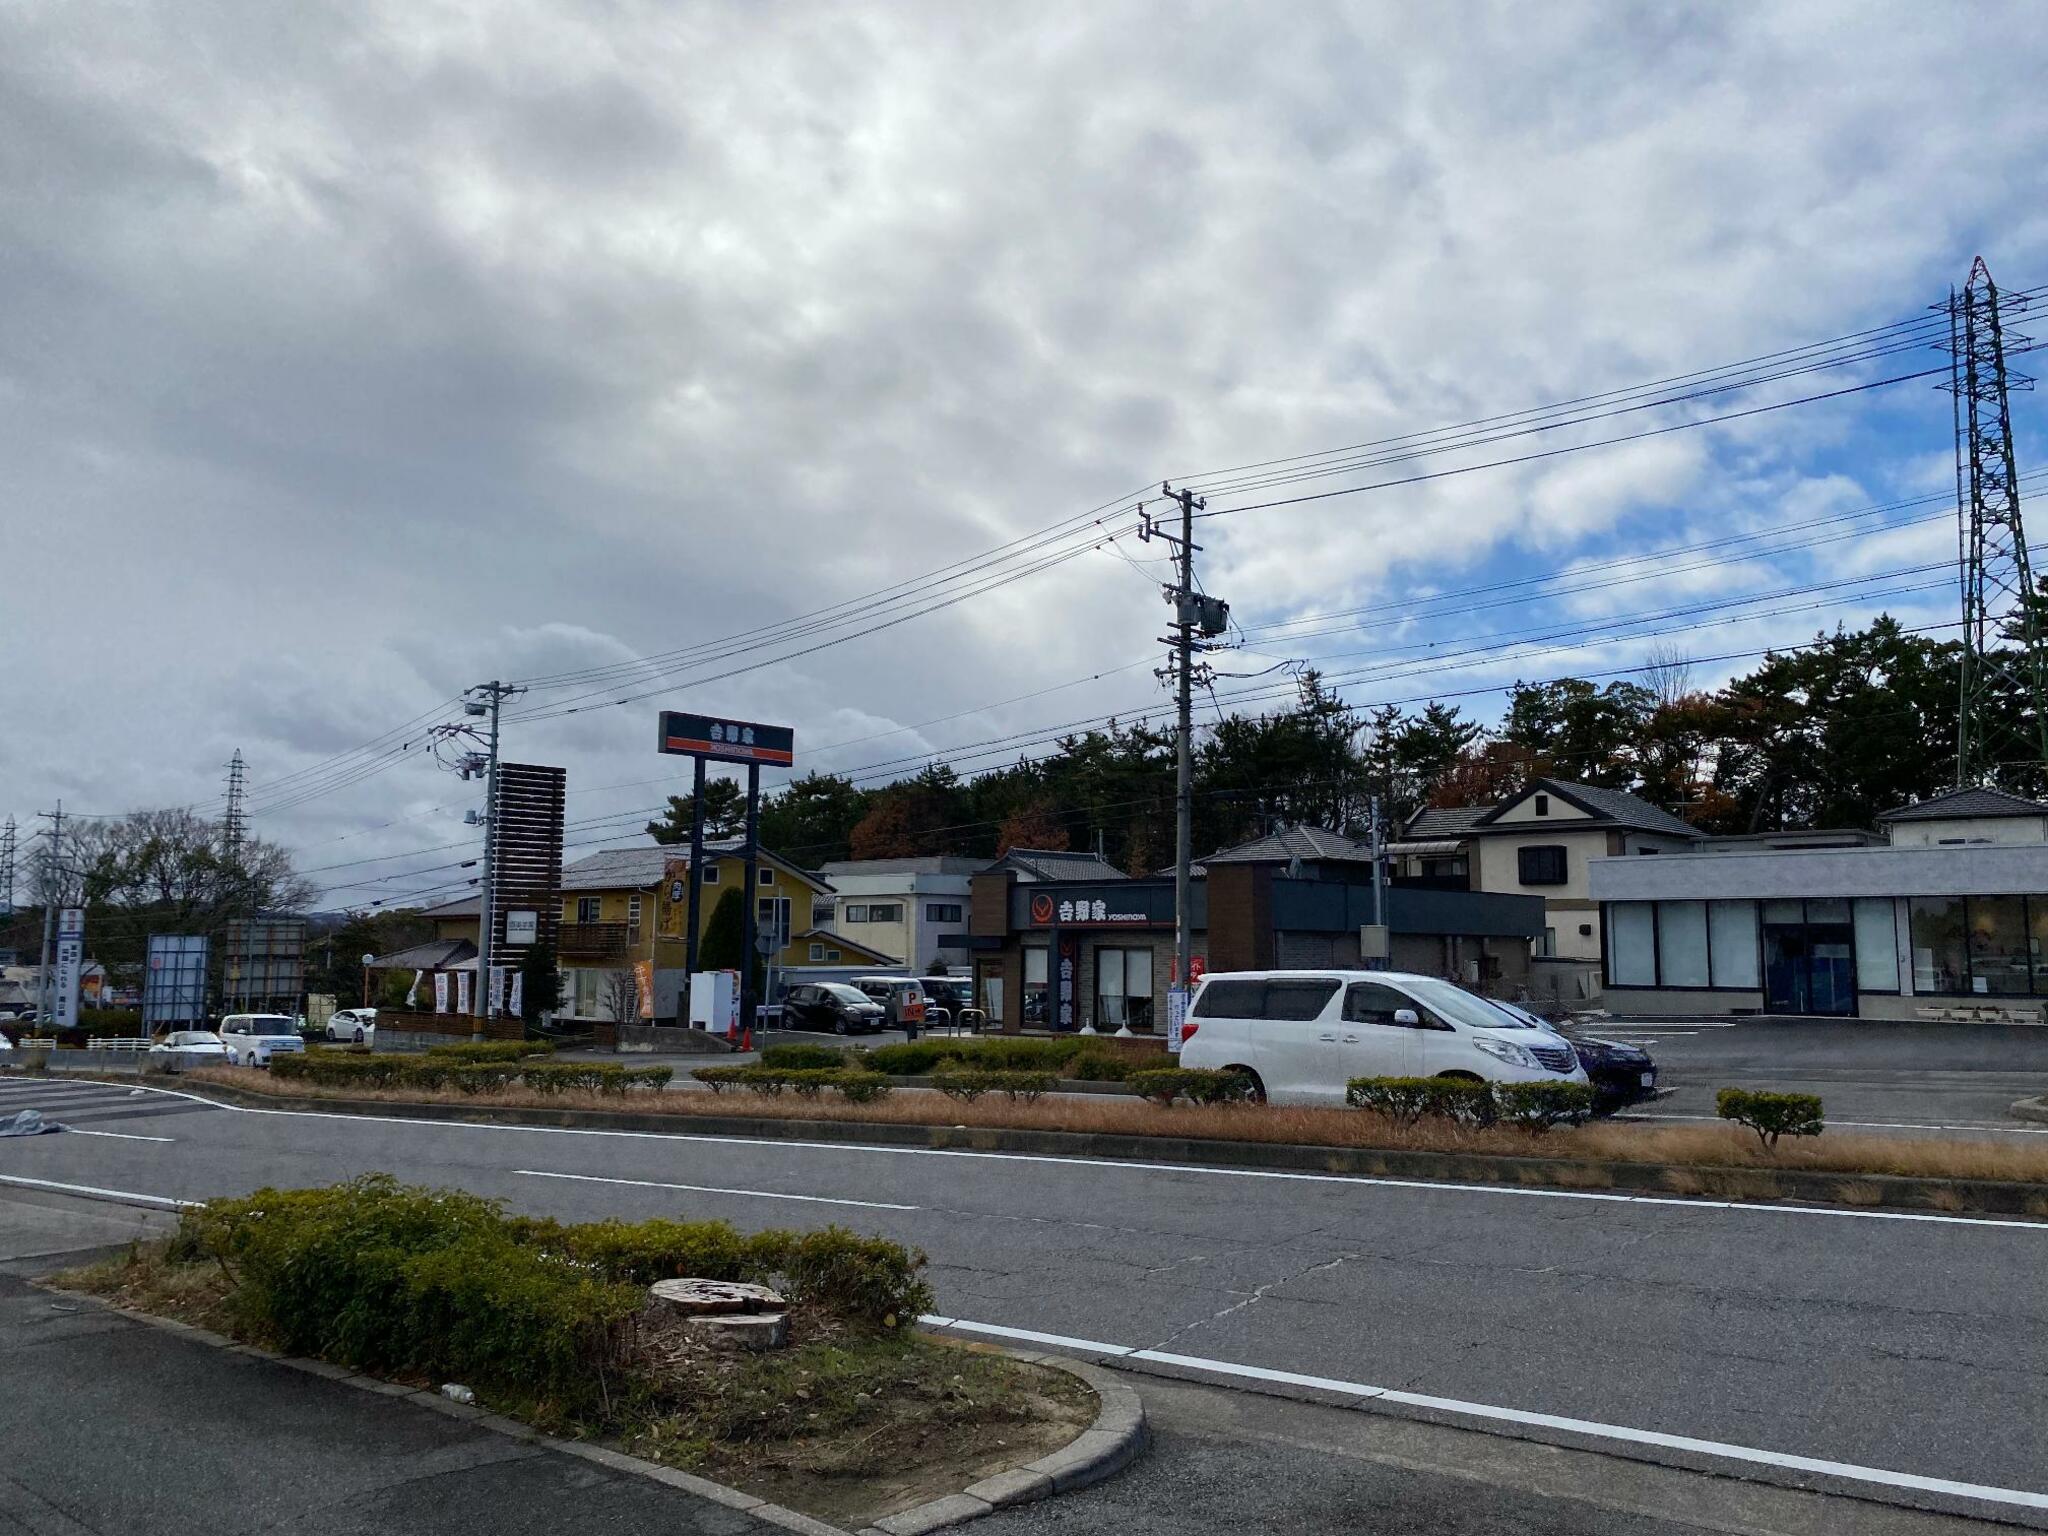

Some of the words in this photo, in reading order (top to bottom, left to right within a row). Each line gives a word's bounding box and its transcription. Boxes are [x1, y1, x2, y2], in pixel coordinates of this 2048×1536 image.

[1059, 899, 1107, 921] 吉野家
[908, 992, 917, 1005] P
[1060, 958, 1073, 1025] 吉野家
[904, 1007, 915, 1017] IN
